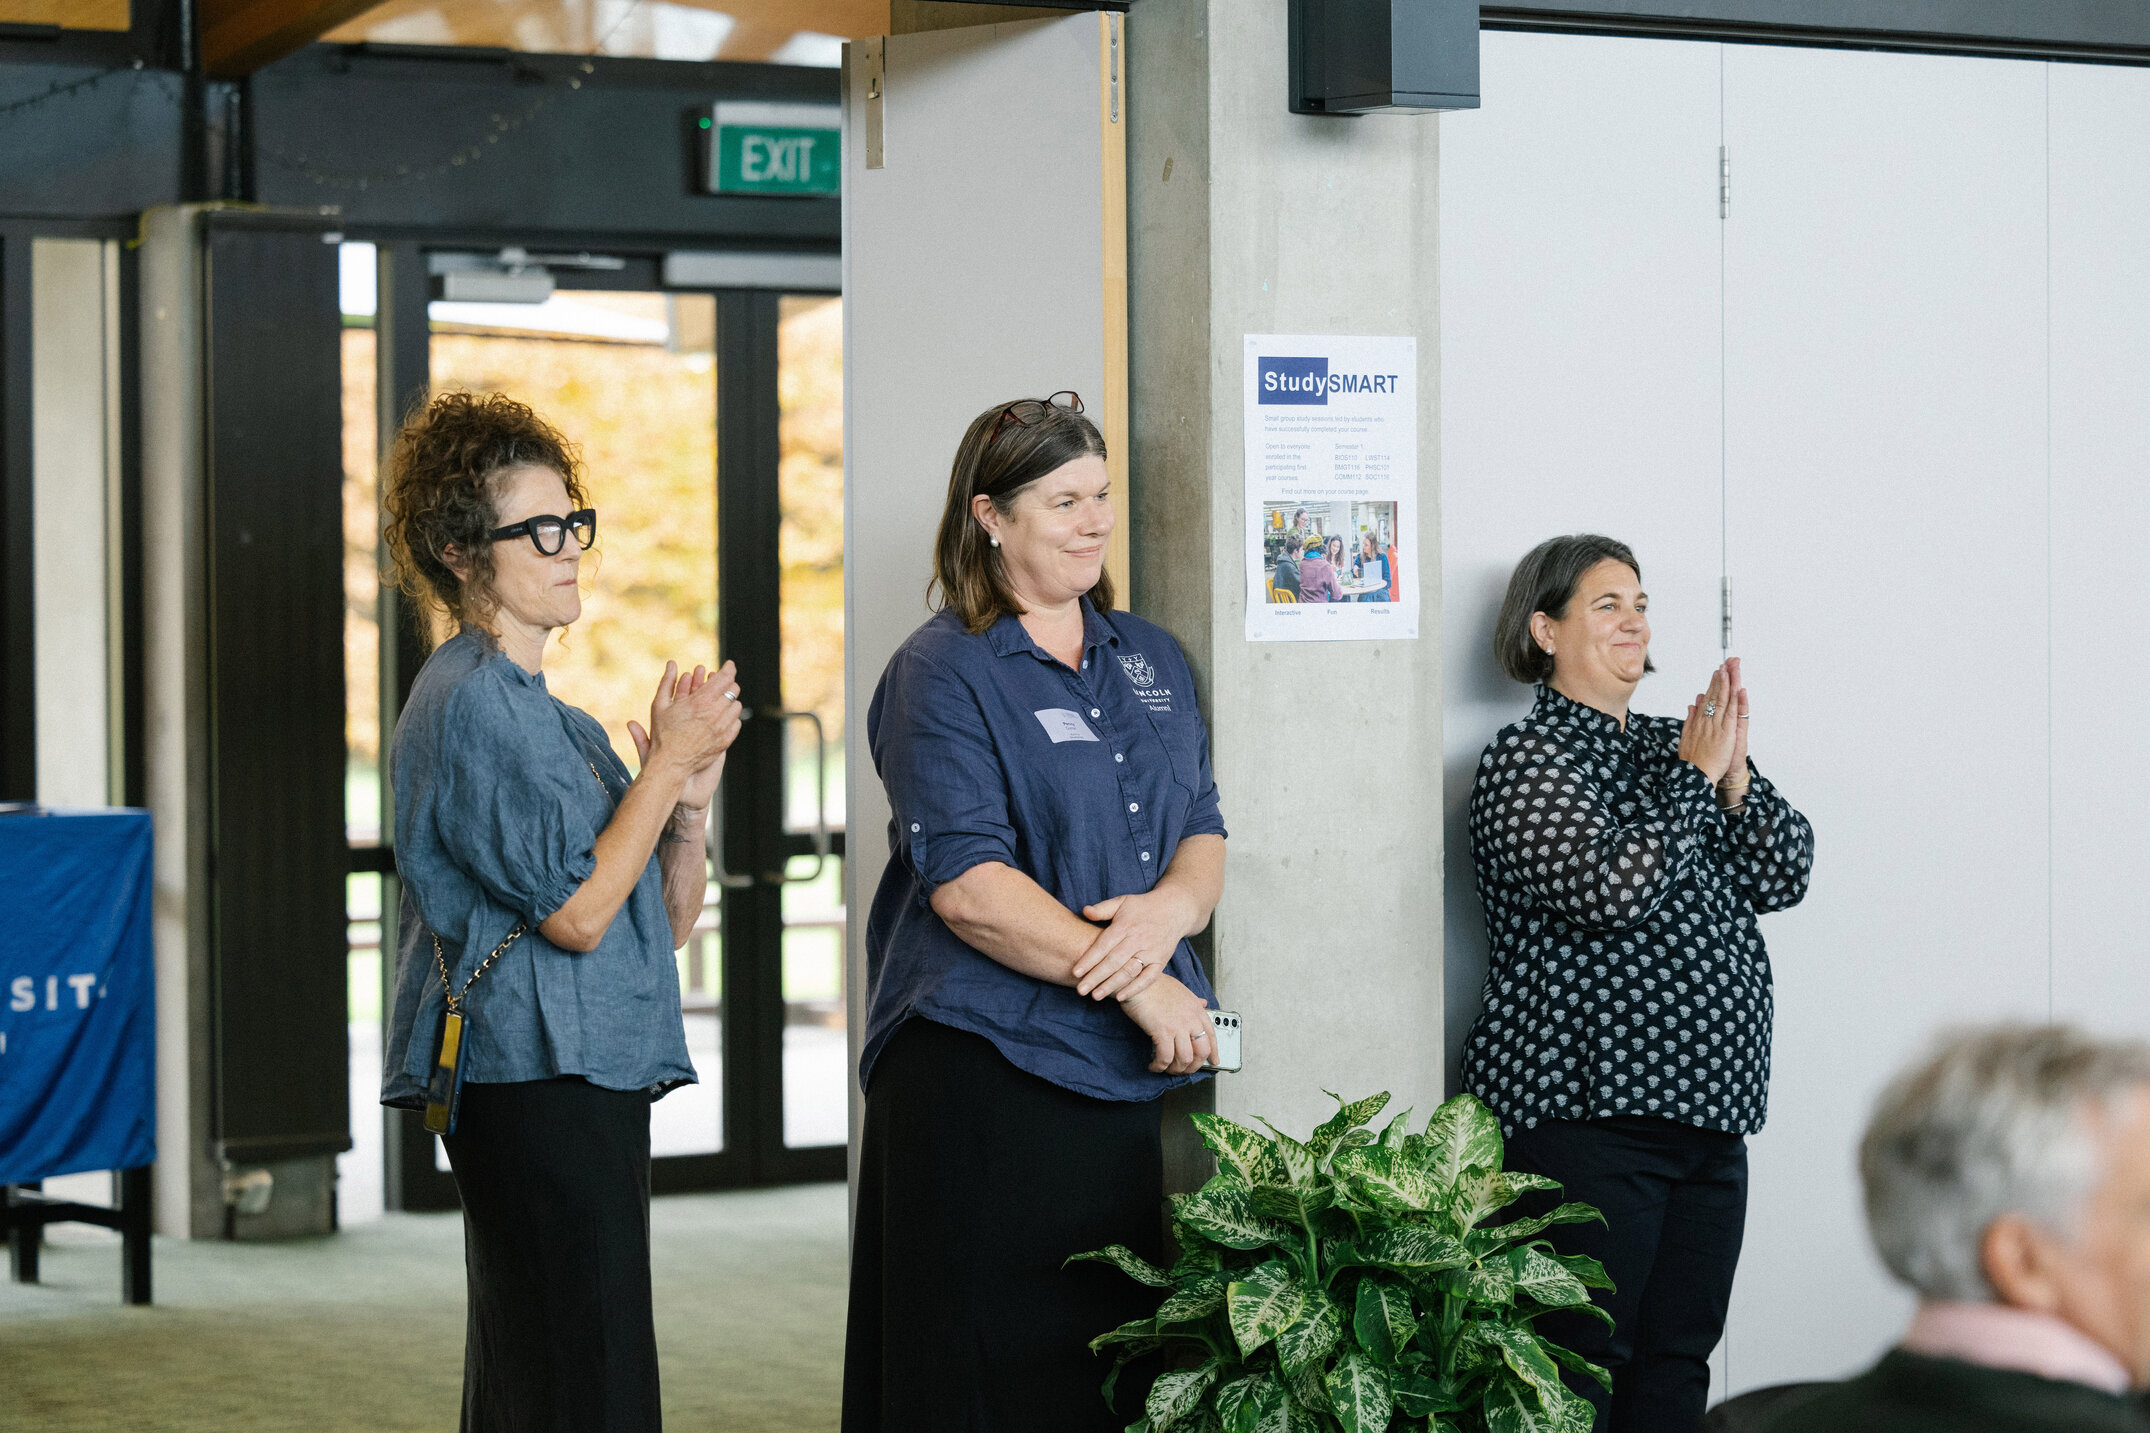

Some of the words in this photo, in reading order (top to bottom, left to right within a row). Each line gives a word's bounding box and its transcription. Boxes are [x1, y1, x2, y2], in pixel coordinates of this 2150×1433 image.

[741, 135, 816, 183] EXIT
[1264, 371, 1398, 397] StudySMART
[1264, 415, 1279, 423] Small
[1280, 416, 1295, 424] group
[1296, 415, 1310, 424] study
[1343, 416, 1350, 424] by
[1279, 426, 1310, 434] successfully
[1310, 426, 1337, 434] completed
[1265, 464, 1296, 472] participating
[1149, 704, 1172, 712] Alumni
[10, 972, 108, 1012] SIT
